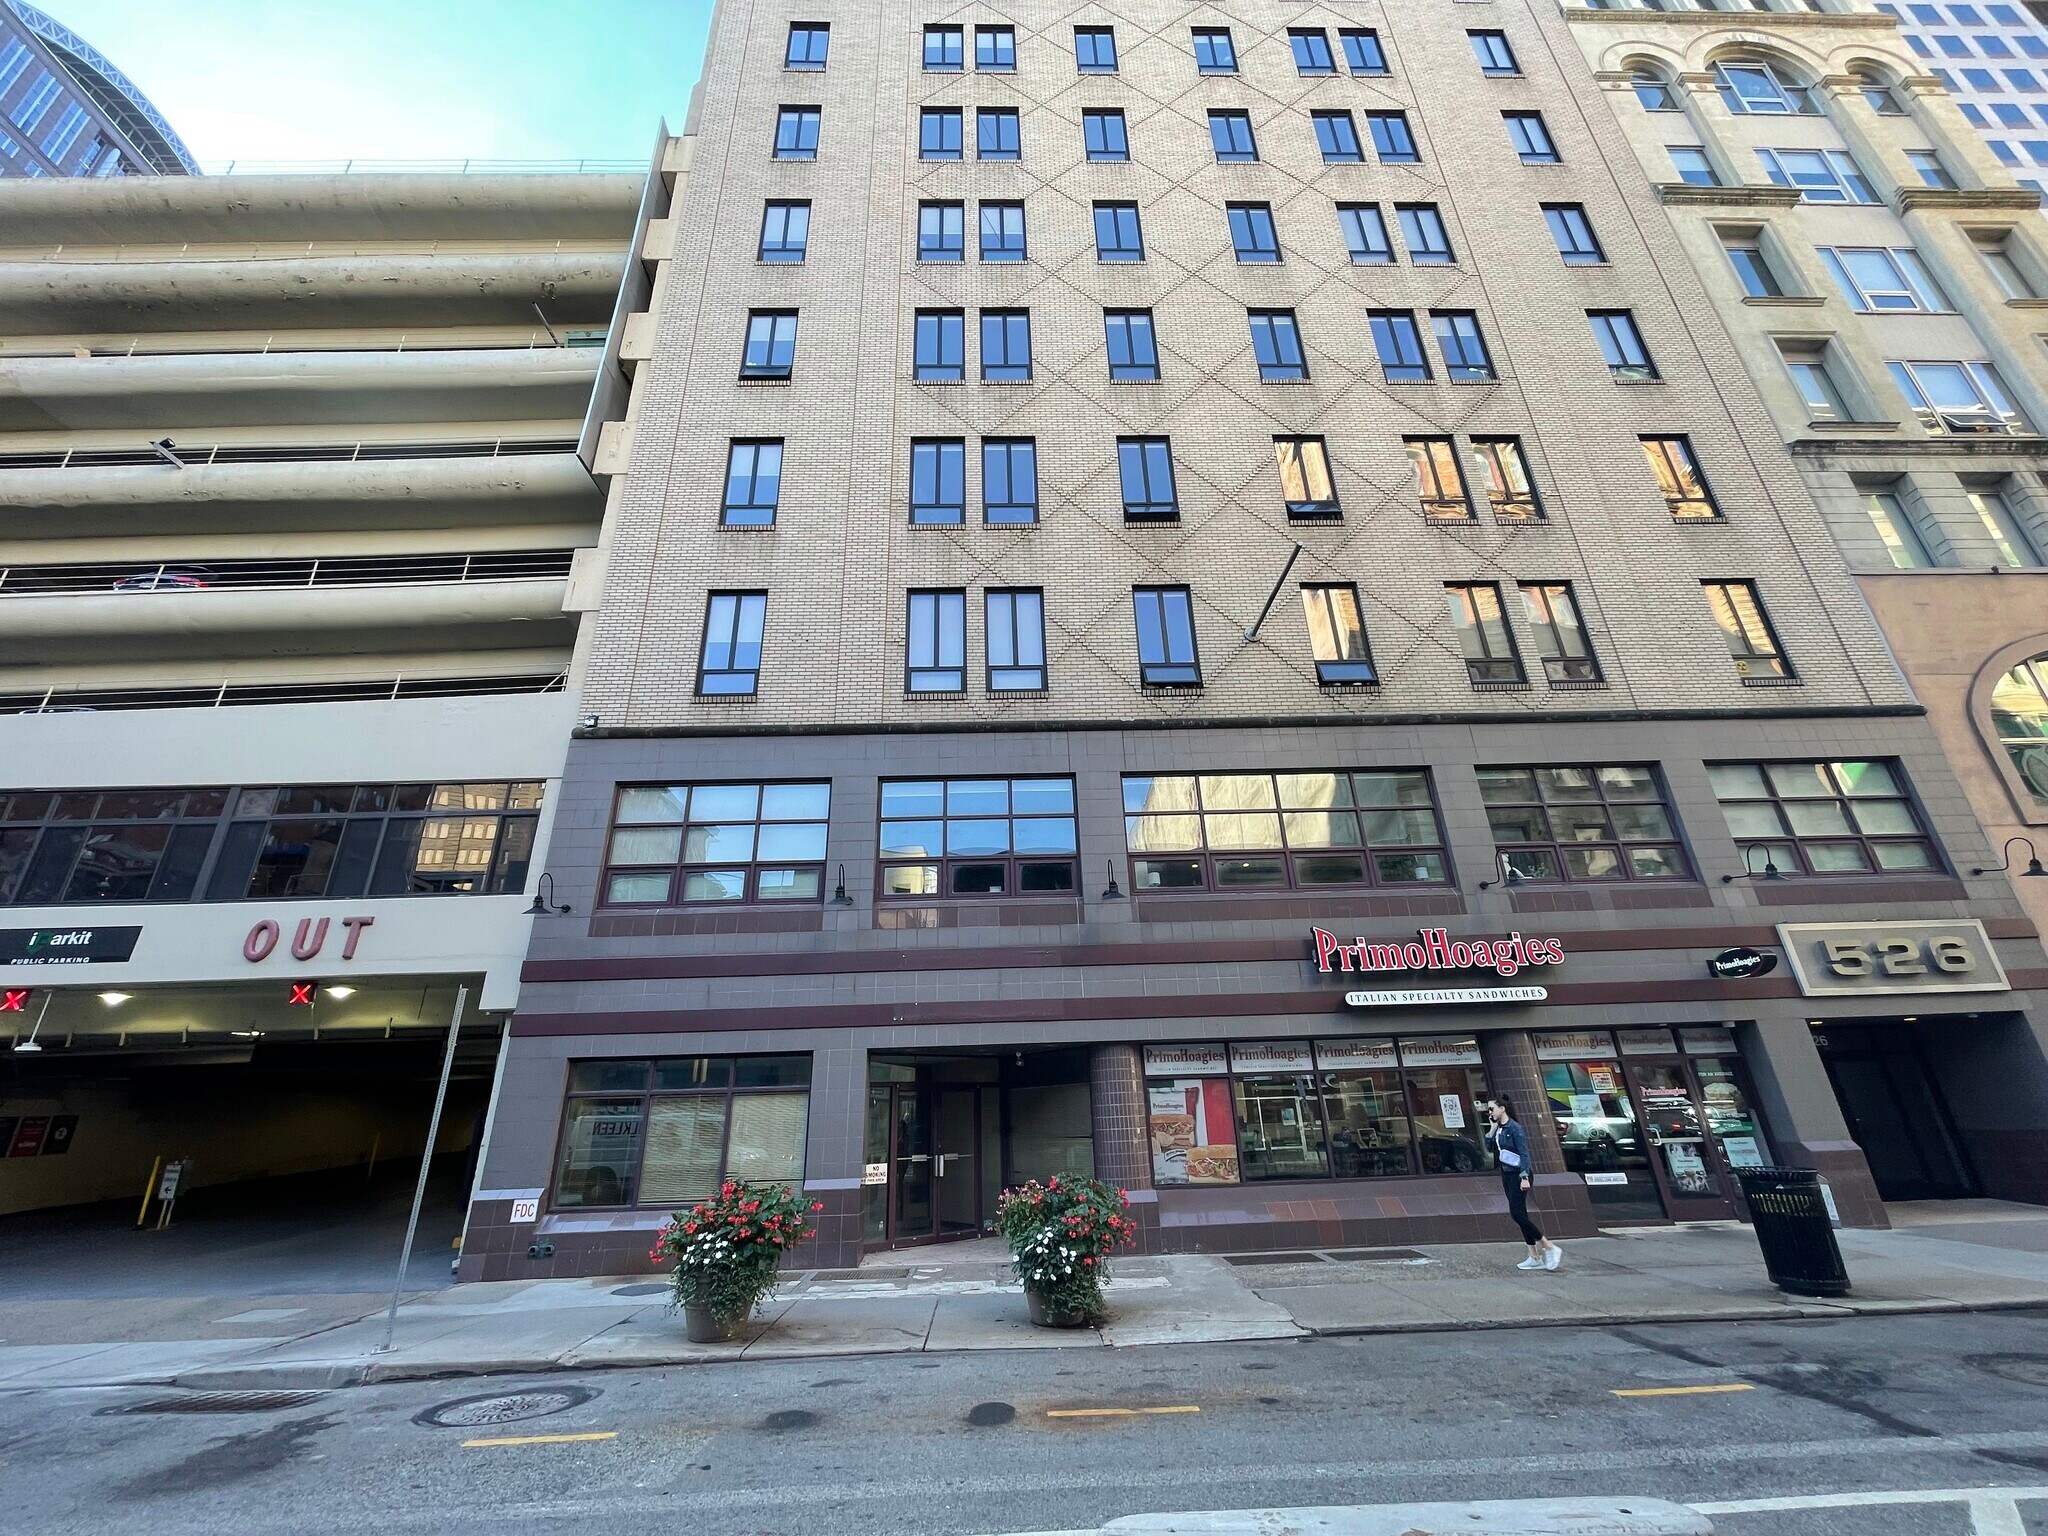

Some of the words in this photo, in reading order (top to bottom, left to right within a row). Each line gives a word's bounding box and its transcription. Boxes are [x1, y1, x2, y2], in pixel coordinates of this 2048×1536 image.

[243, 916, 375, 962] OUT
[1313, 927, 1565, 976] PrimoHoagies
[1818, 936, 1976, 976] 526
[1715, 955, 1761, 970] PrimoHoagies
[1350, 994, 1397, 1002] ITALIAN
[1402, 992, 1463, 1001] SPECIALTY
[1469, 989, 1543, 999] SANDWICHES
[1401, 1041, 1478, 1056] PrimoHoagies
[1535, 1034, 1611, 1049] PrimoHoagies
[1813, 1036, 1828, 1046] 26
[1146, 1048, 1225, 1064] PrimoHoagies
[1232, 1046, 1310, 1061] PrimoHoagies
[1317, 1043, 1394, 1058] PrimoHoagies
[514, 1203, 535, 1218] FDC
